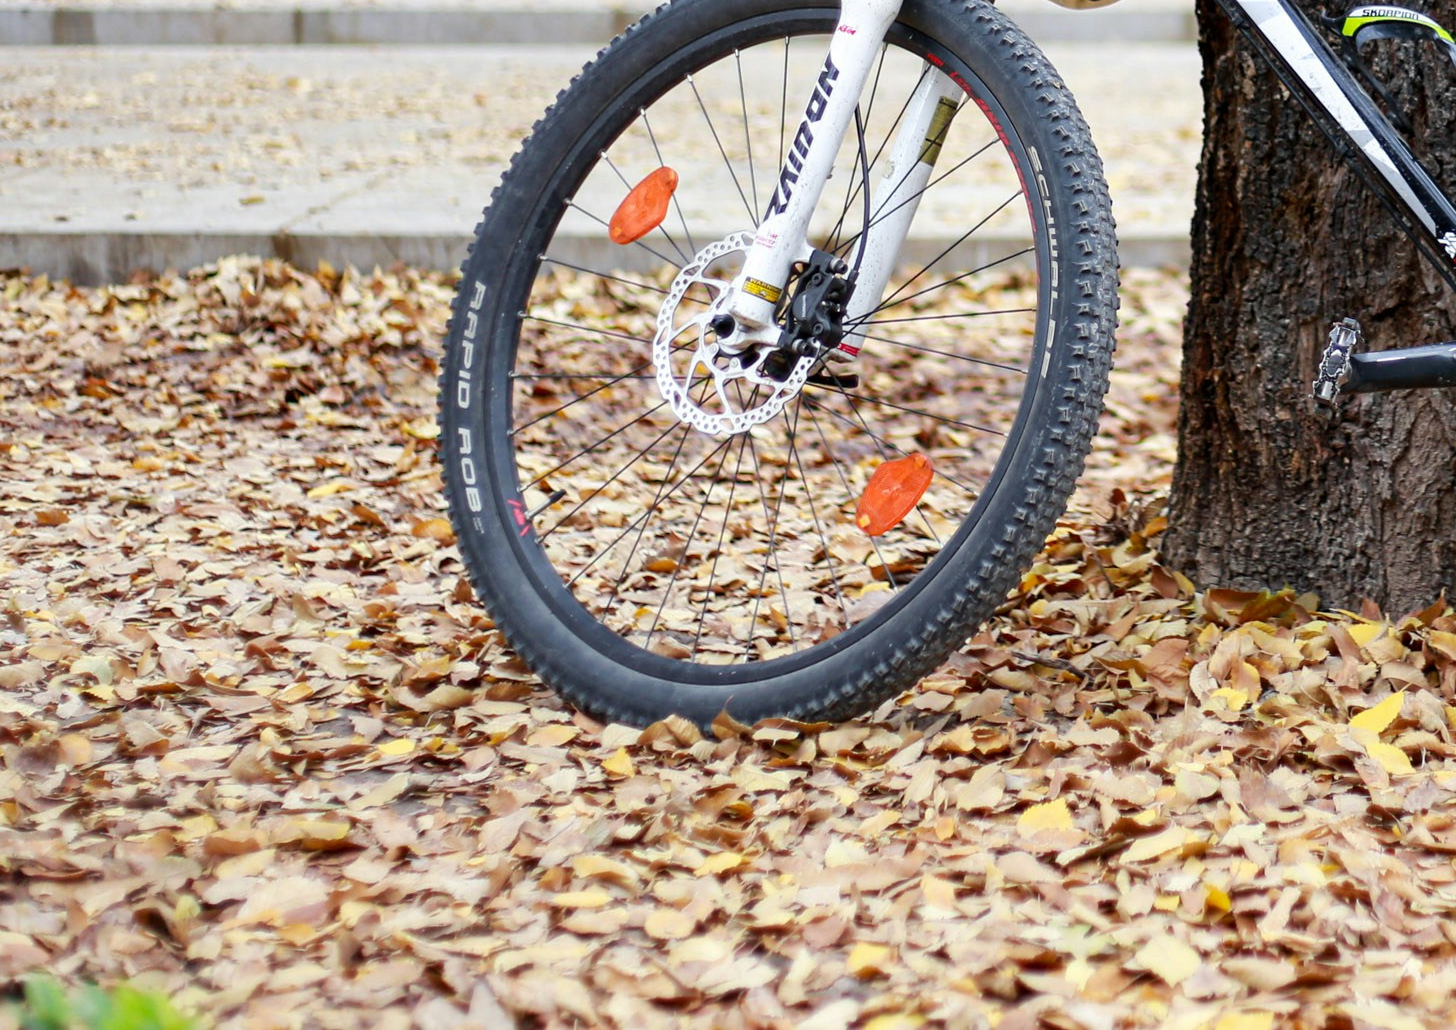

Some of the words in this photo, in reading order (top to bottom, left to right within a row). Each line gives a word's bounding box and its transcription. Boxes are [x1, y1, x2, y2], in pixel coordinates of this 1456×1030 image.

[1362, 8, 1420, 21] SKORPION
[763, 49, 841, 220] RAIDON
[1028, 145, 1060, 379] SCHWALBE
[457, 280, 487, 410] RAPID
[457, 426, 483, 514] ROB
